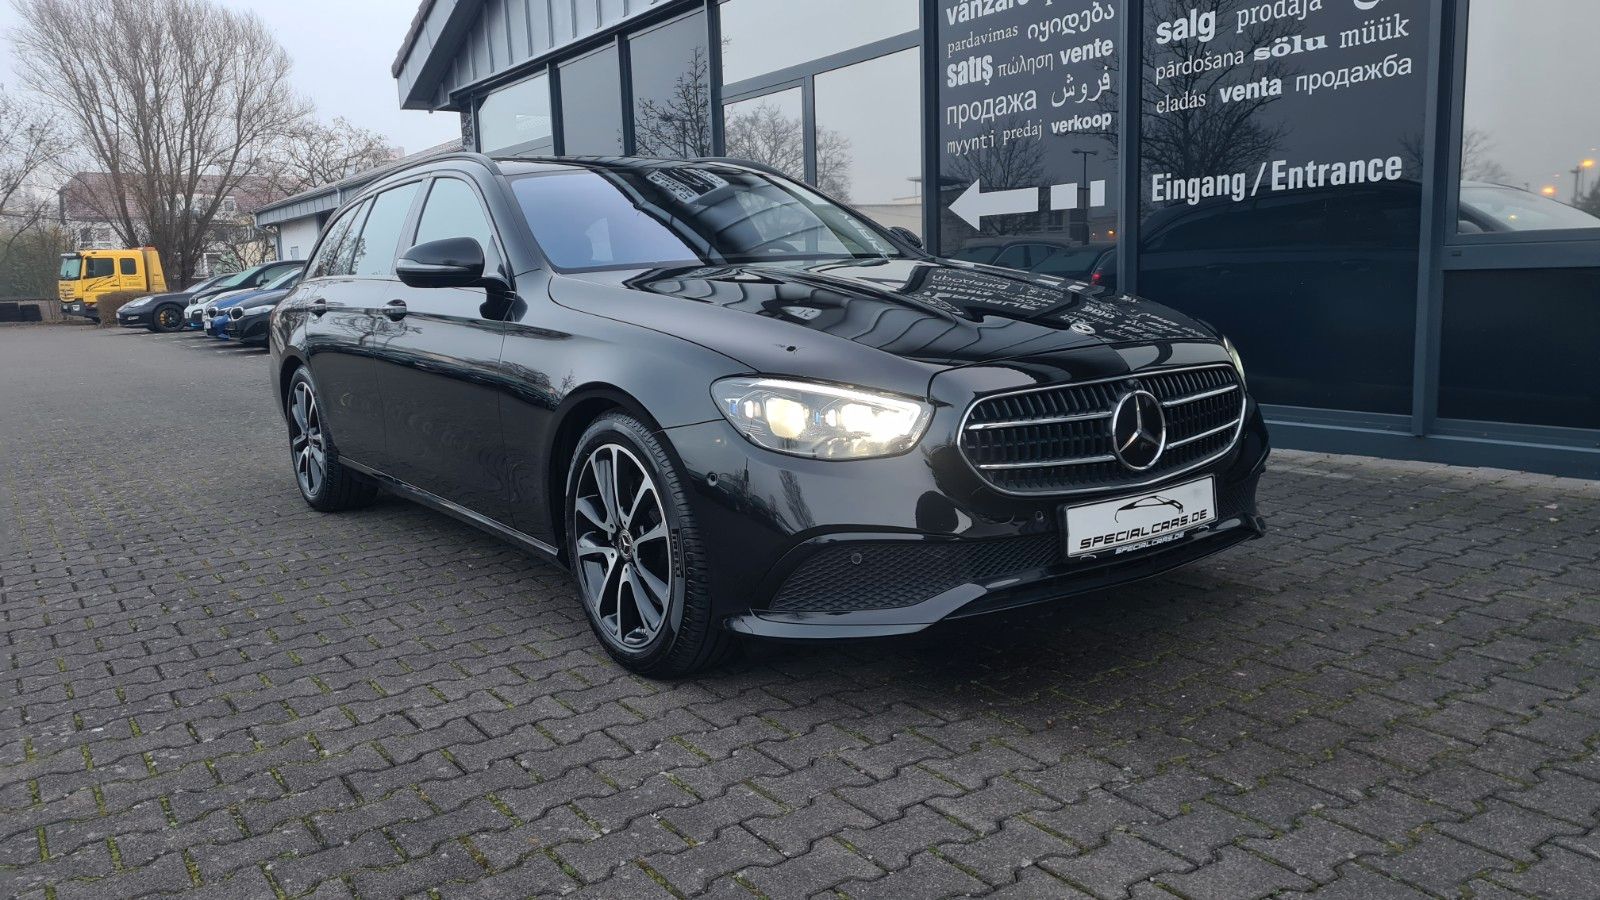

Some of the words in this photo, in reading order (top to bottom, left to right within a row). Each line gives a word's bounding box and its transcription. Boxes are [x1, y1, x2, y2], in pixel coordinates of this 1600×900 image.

[947, 25, 1019, 58] pardavimas
[1027, 1, 1115, 42] იყიდება
[1156, 8, 1216, 44] salg
[998, 53, 1054, 77] πώληση
[1060, 38, 1114, 65] vente
[1155, 50, 1245, 85] pārdošana
[1253, 35, 1328, 61] sölu
[1339, 13, 1409, 48] müük
[946, 54, 994, 88] satış
[1051, 65, 1112, 108] فروش
[1295, 54, 1412, 95] продажба
[947, 89, 1038, 130] продажа
[1156, 92, 1207, 114] eladás
[1219, 77, 1283, 104] venta
[947, 129, 996, 157] myynti
[1003, 119, 1043, 146] predaj
[1051, 112, 1113, 134] verkoop
[1079, 508, 1208, 551] SPECIALCARS.DE
